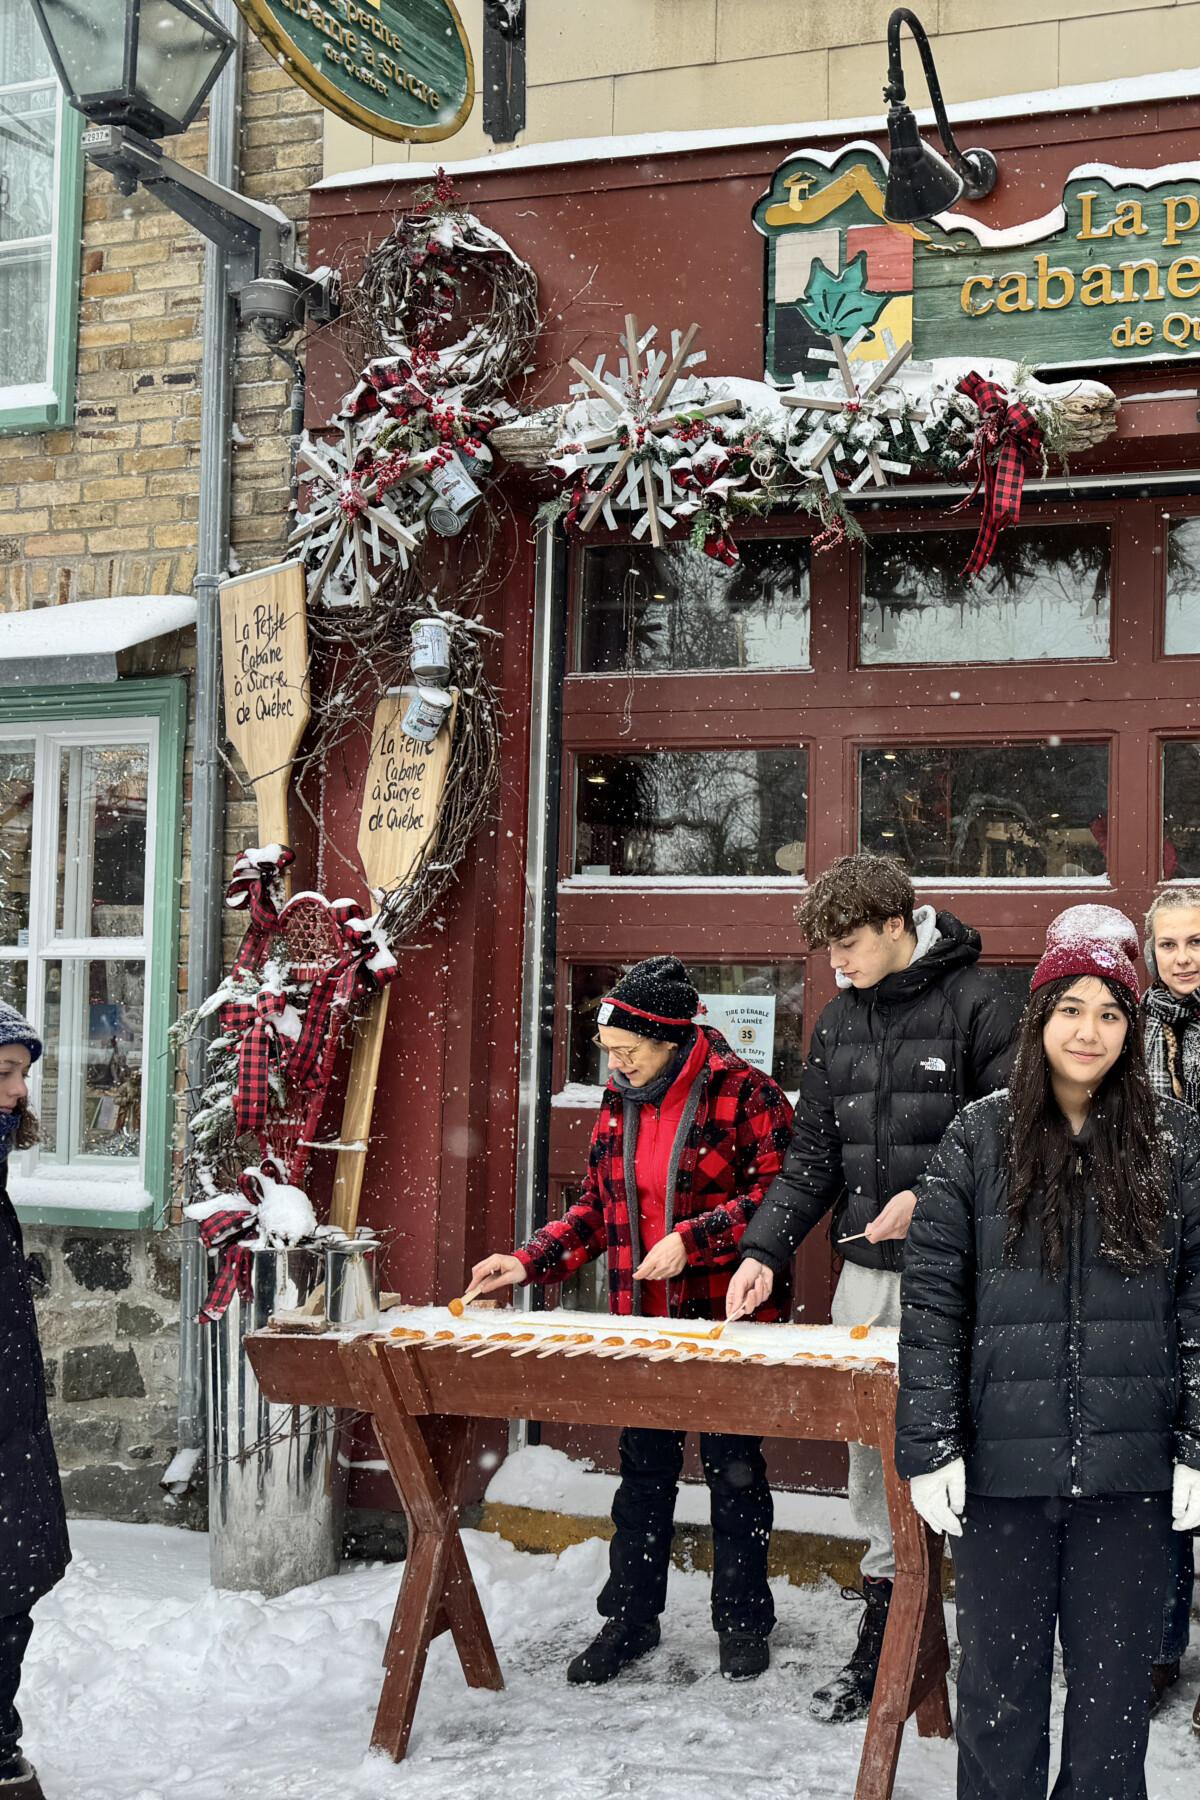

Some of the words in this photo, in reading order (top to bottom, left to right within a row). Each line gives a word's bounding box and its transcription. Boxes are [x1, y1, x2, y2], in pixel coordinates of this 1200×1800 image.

[322, 42, 341, 64] de
[378, 52, 440, 111] sucre
[1076, 190, 1148, 240] La
[1111, 317, 1153, 348] de
[234, 612, 250, 643] La
[253, 602, 287, 641] Petite
[241, 644, 283, 673] Cabane
[234, 675, 243, 696] à
[247, 671, 288, 692] Sucre
[236, 701, 251, 725] de
[256, 688, 294, 721] Québec
[380, 728, 394, 755] La
[385, 757, 426, 782] Cabane
[372, 778, 381, 800] à
[383, 782, 421, 803] Sucre
[369, 805, 384, 831] de
[386, 803, 424, 832] Québec
